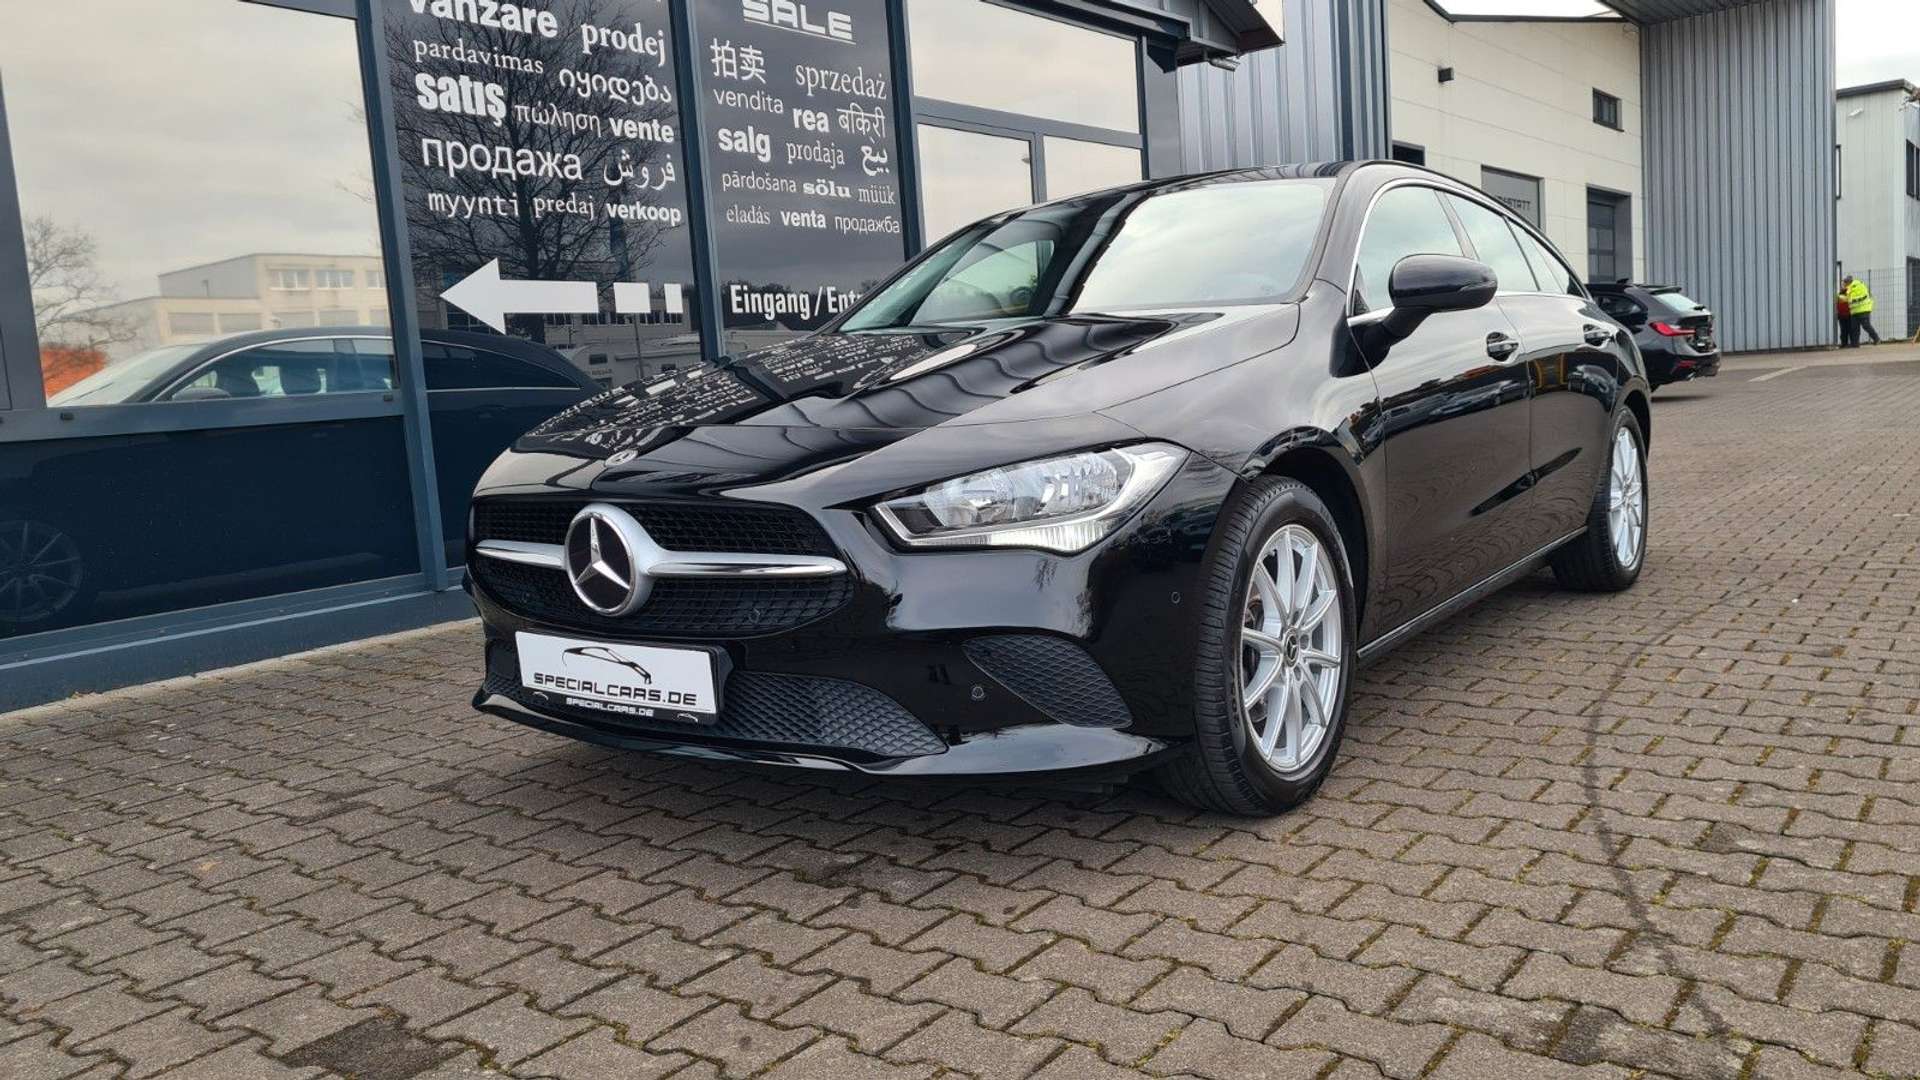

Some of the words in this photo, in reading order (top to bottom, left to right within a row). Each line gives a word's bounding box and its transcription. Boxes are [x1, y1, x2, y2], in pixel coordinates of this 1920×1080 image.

[742, 0, 853, 39] SALE
[413, 39, 544, 73] pardavimas
[581, 22, 665, 67] prodej
[710, 39, 766, 84] 拍卖
[795, 64, 887, 100] sprzedaż
[416, 73, 507, 126] satış
[713, 88, 783, 113] vendita
[514, 102, 602, 136] πώληση
[609, 117, 674, 142] vente
[793, 108, 829, 132] rea
[718, 126, 771, 162] salg
[786, 142, 845, 168] prodaja
[422, 139, 582, 180] продажа
[722, 171, 797, 193] pārdošana
[803, 179, 851, 198] sölu
[428, 192, 519, 217] myynti
[534, 195, 594, 220] predaj
[858, 186, 895, 205] müük
[607, 202, 681, 226] verkoop
[727, 205, 770, 224] eladás
[781, 211, 826, 228] venta
[835, 216, 900, 234] продажба
[730, 285, 811, 321] Eingang
